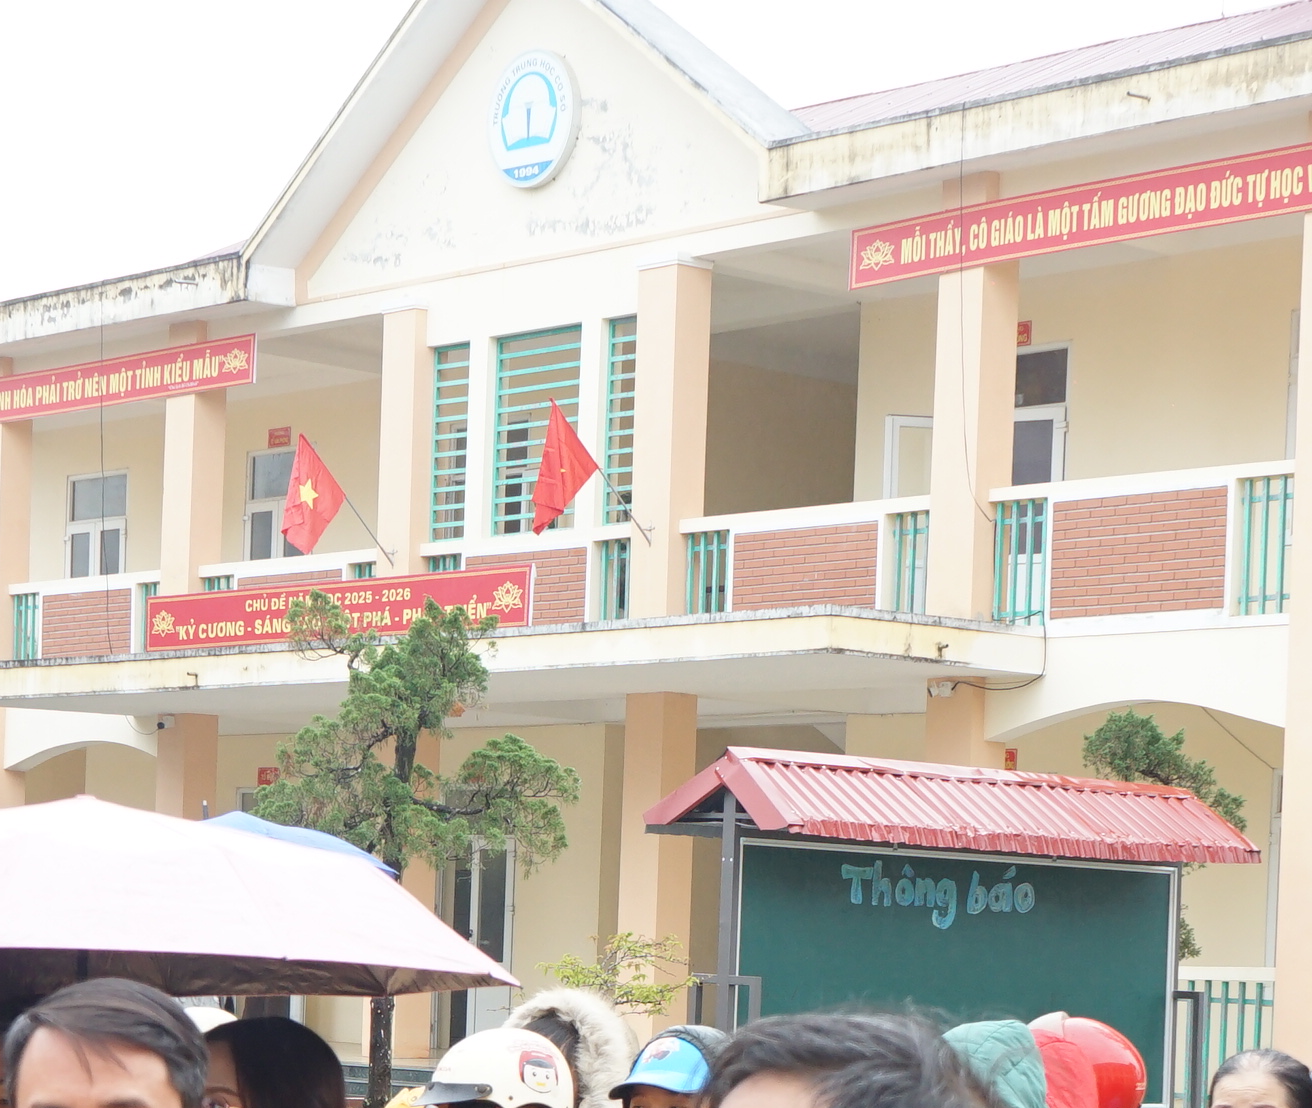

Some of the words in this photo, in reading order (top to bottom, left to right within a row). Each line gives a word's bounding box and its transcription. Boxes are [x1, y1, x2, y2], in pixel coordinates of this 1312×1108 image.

[900, 226, 926, 265] MỖI
[929, 219, 965, 257] THẦY,
[969, 218, 988, 251] CÔ
[991, 211, 1023, 248] GIÁO
[1027, 206, 1044, 241] LÀ
[1047, 205, 1079, 241] MỘT
[1082, 191, 1114, 232] TẤM
[1117, 189, 1170, 225] GƯƠNG
[1174, 184, 1207, 219] ĐẠO
[1210, 173, 1242, 210] ĐỨC
[1246, 168, 1269, 208] TỰ
[1270, 165, 1303, 206] HỌC
[13, 384, 33, 409] HÓA
[35, 375, 60, 406] PHẢI
[62, 371, 84, 402] TRỞ
[84, 372, 107, 398] NÊN
[109, 368, 134, 397] MỘT
[135, 361, 161, 389] TỈNH
[164, 353, 190, 385] KIỂU
[198, 621, 244, 639] CƯƠNG
[254, 615, 291, 635] SÁNG
[245, 593, 268, 612] CHỦ
[271, 592, 286, 610] ĐỀ
[344, 591, 372, 605] 2025
[382, 588, 411, 602] 2026
[841, 860, 957, 929] Thông
[967, 865, 1036, 915] báo
